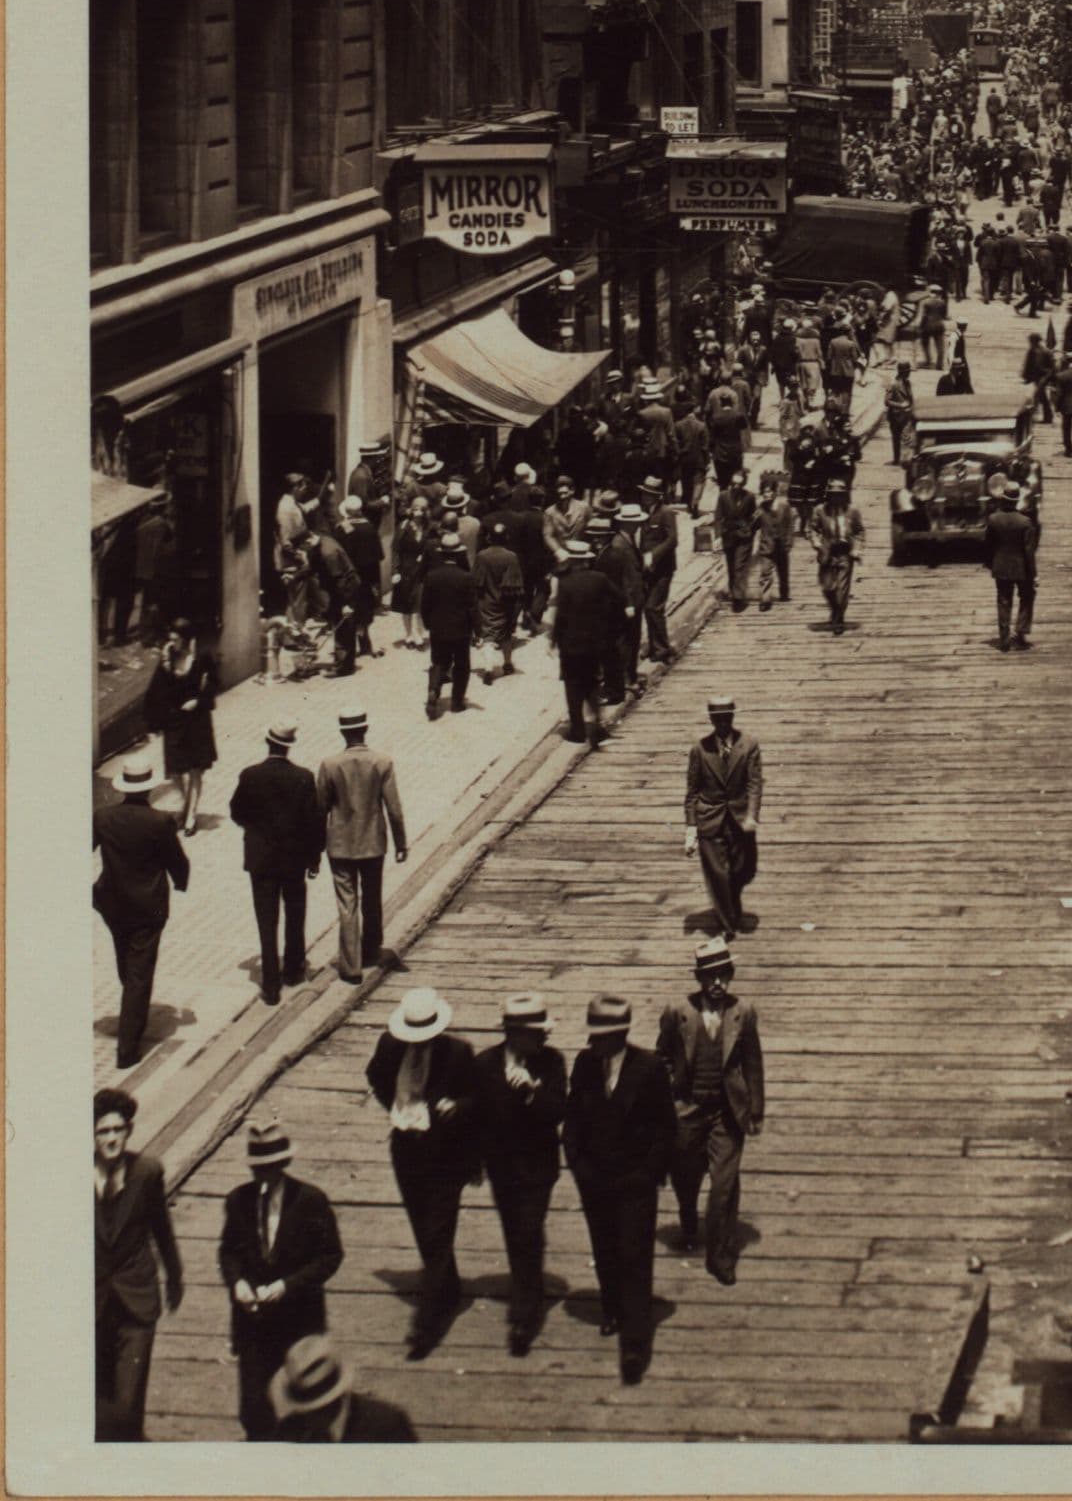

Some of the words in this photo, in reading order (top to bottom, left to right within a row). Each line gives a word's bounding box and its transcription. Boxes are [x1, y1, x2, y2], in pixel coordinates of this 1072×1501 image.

[664, 111, 697, 121] BUILDING
[666, 122, 676, 133] TO
[679, 122, 696, 133] LET
[677, 162, 778, 179] DRUGS
[687, 180, 770, 198] SODA
[427, 175, 548, 221] MIRROR
[675, 198, 779, 210] LUNCHEONETTE
[449, 213, 526, 228] CANDIES
[692, 219, 767, 231] PERFUMES
[463, 231, 512, 247] SODA
